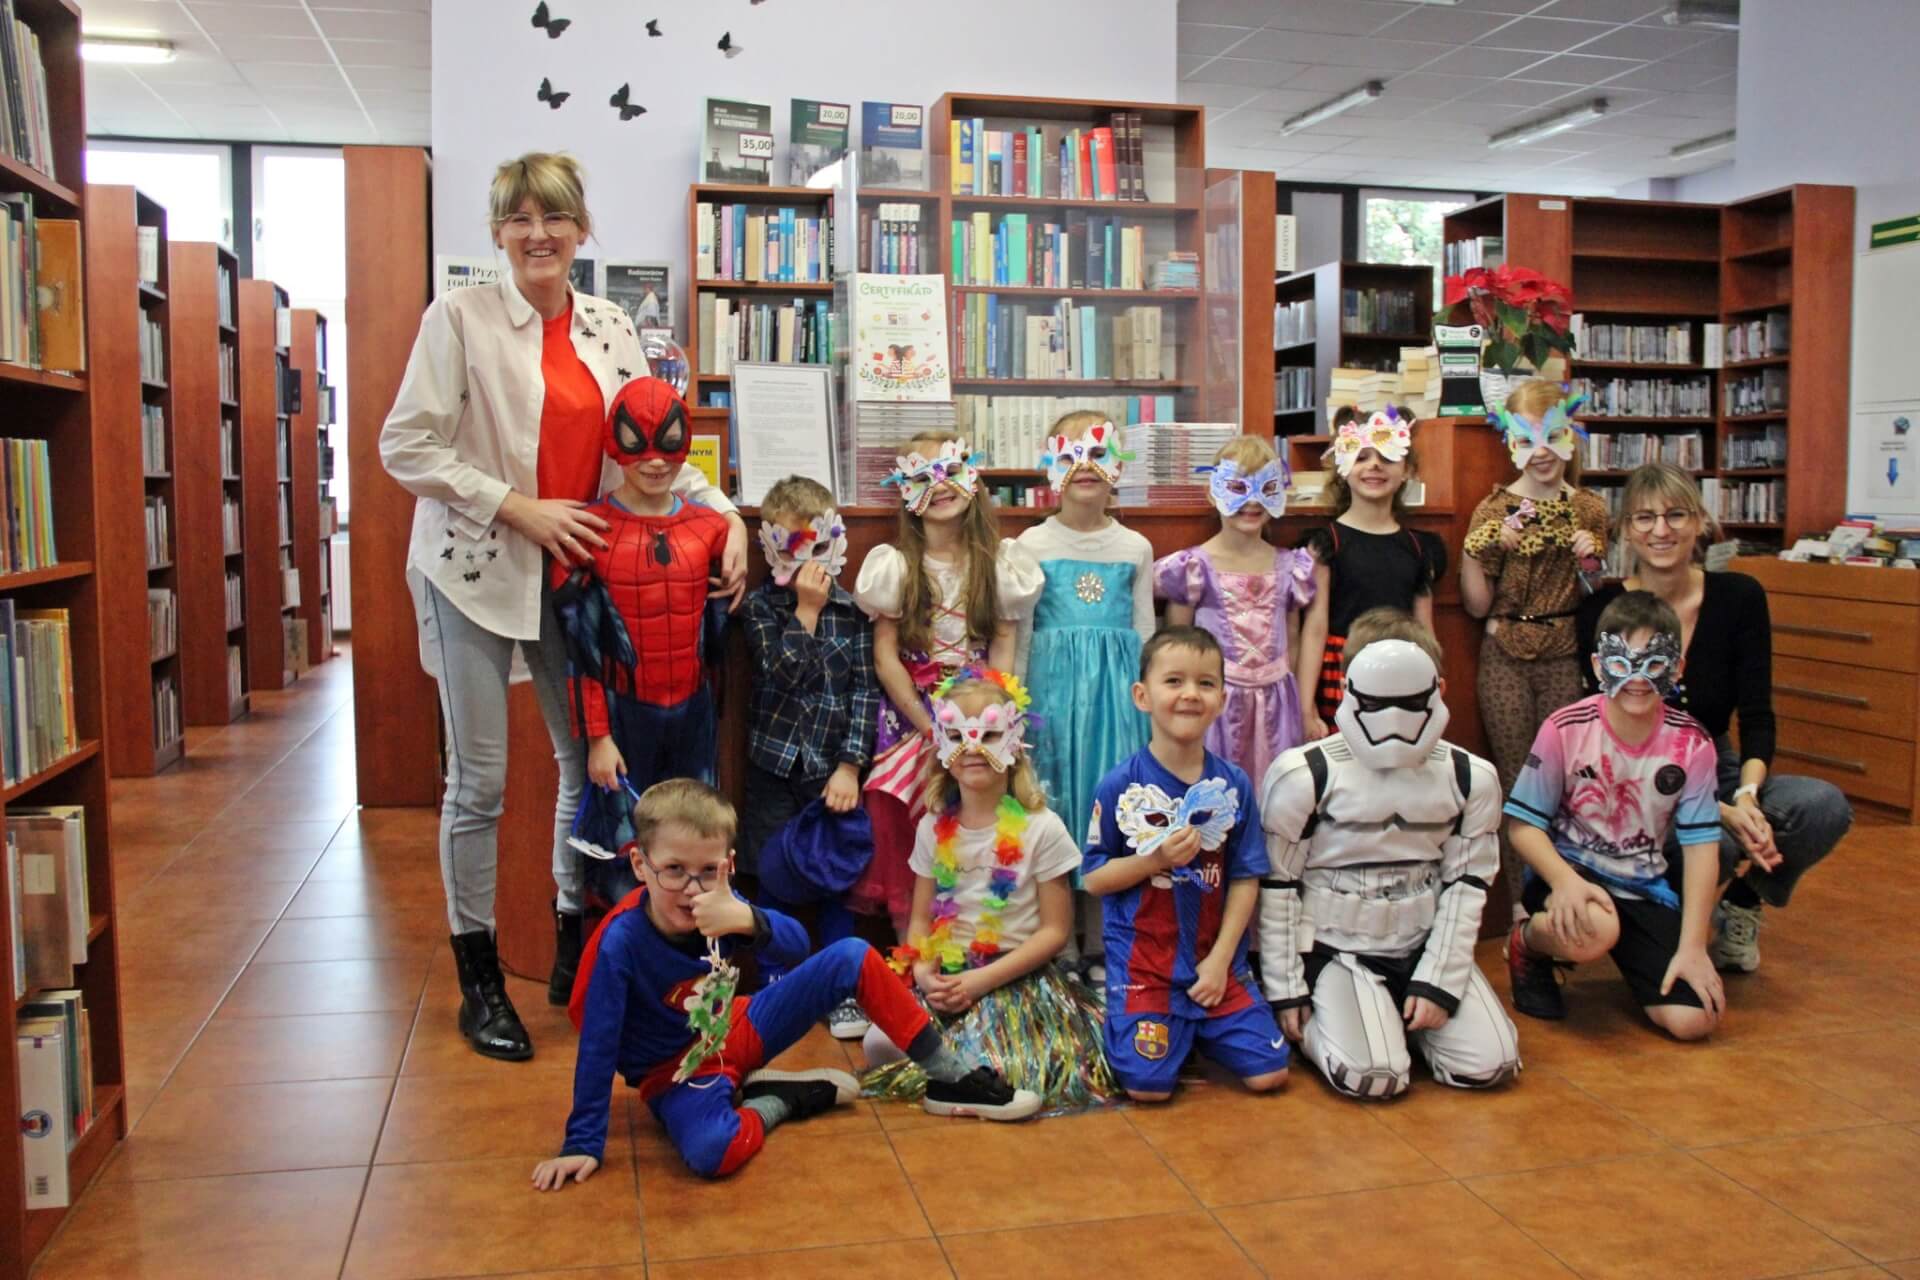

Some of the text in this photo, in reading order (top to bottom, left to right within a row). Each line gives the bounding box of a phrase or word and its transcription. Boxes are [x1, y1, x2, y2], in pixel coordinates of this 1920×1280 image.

[822, 109, 846, 121] 20,00
[894, 111, 918, 122] 20,00
[743, 138, 771, 151] 35,00
